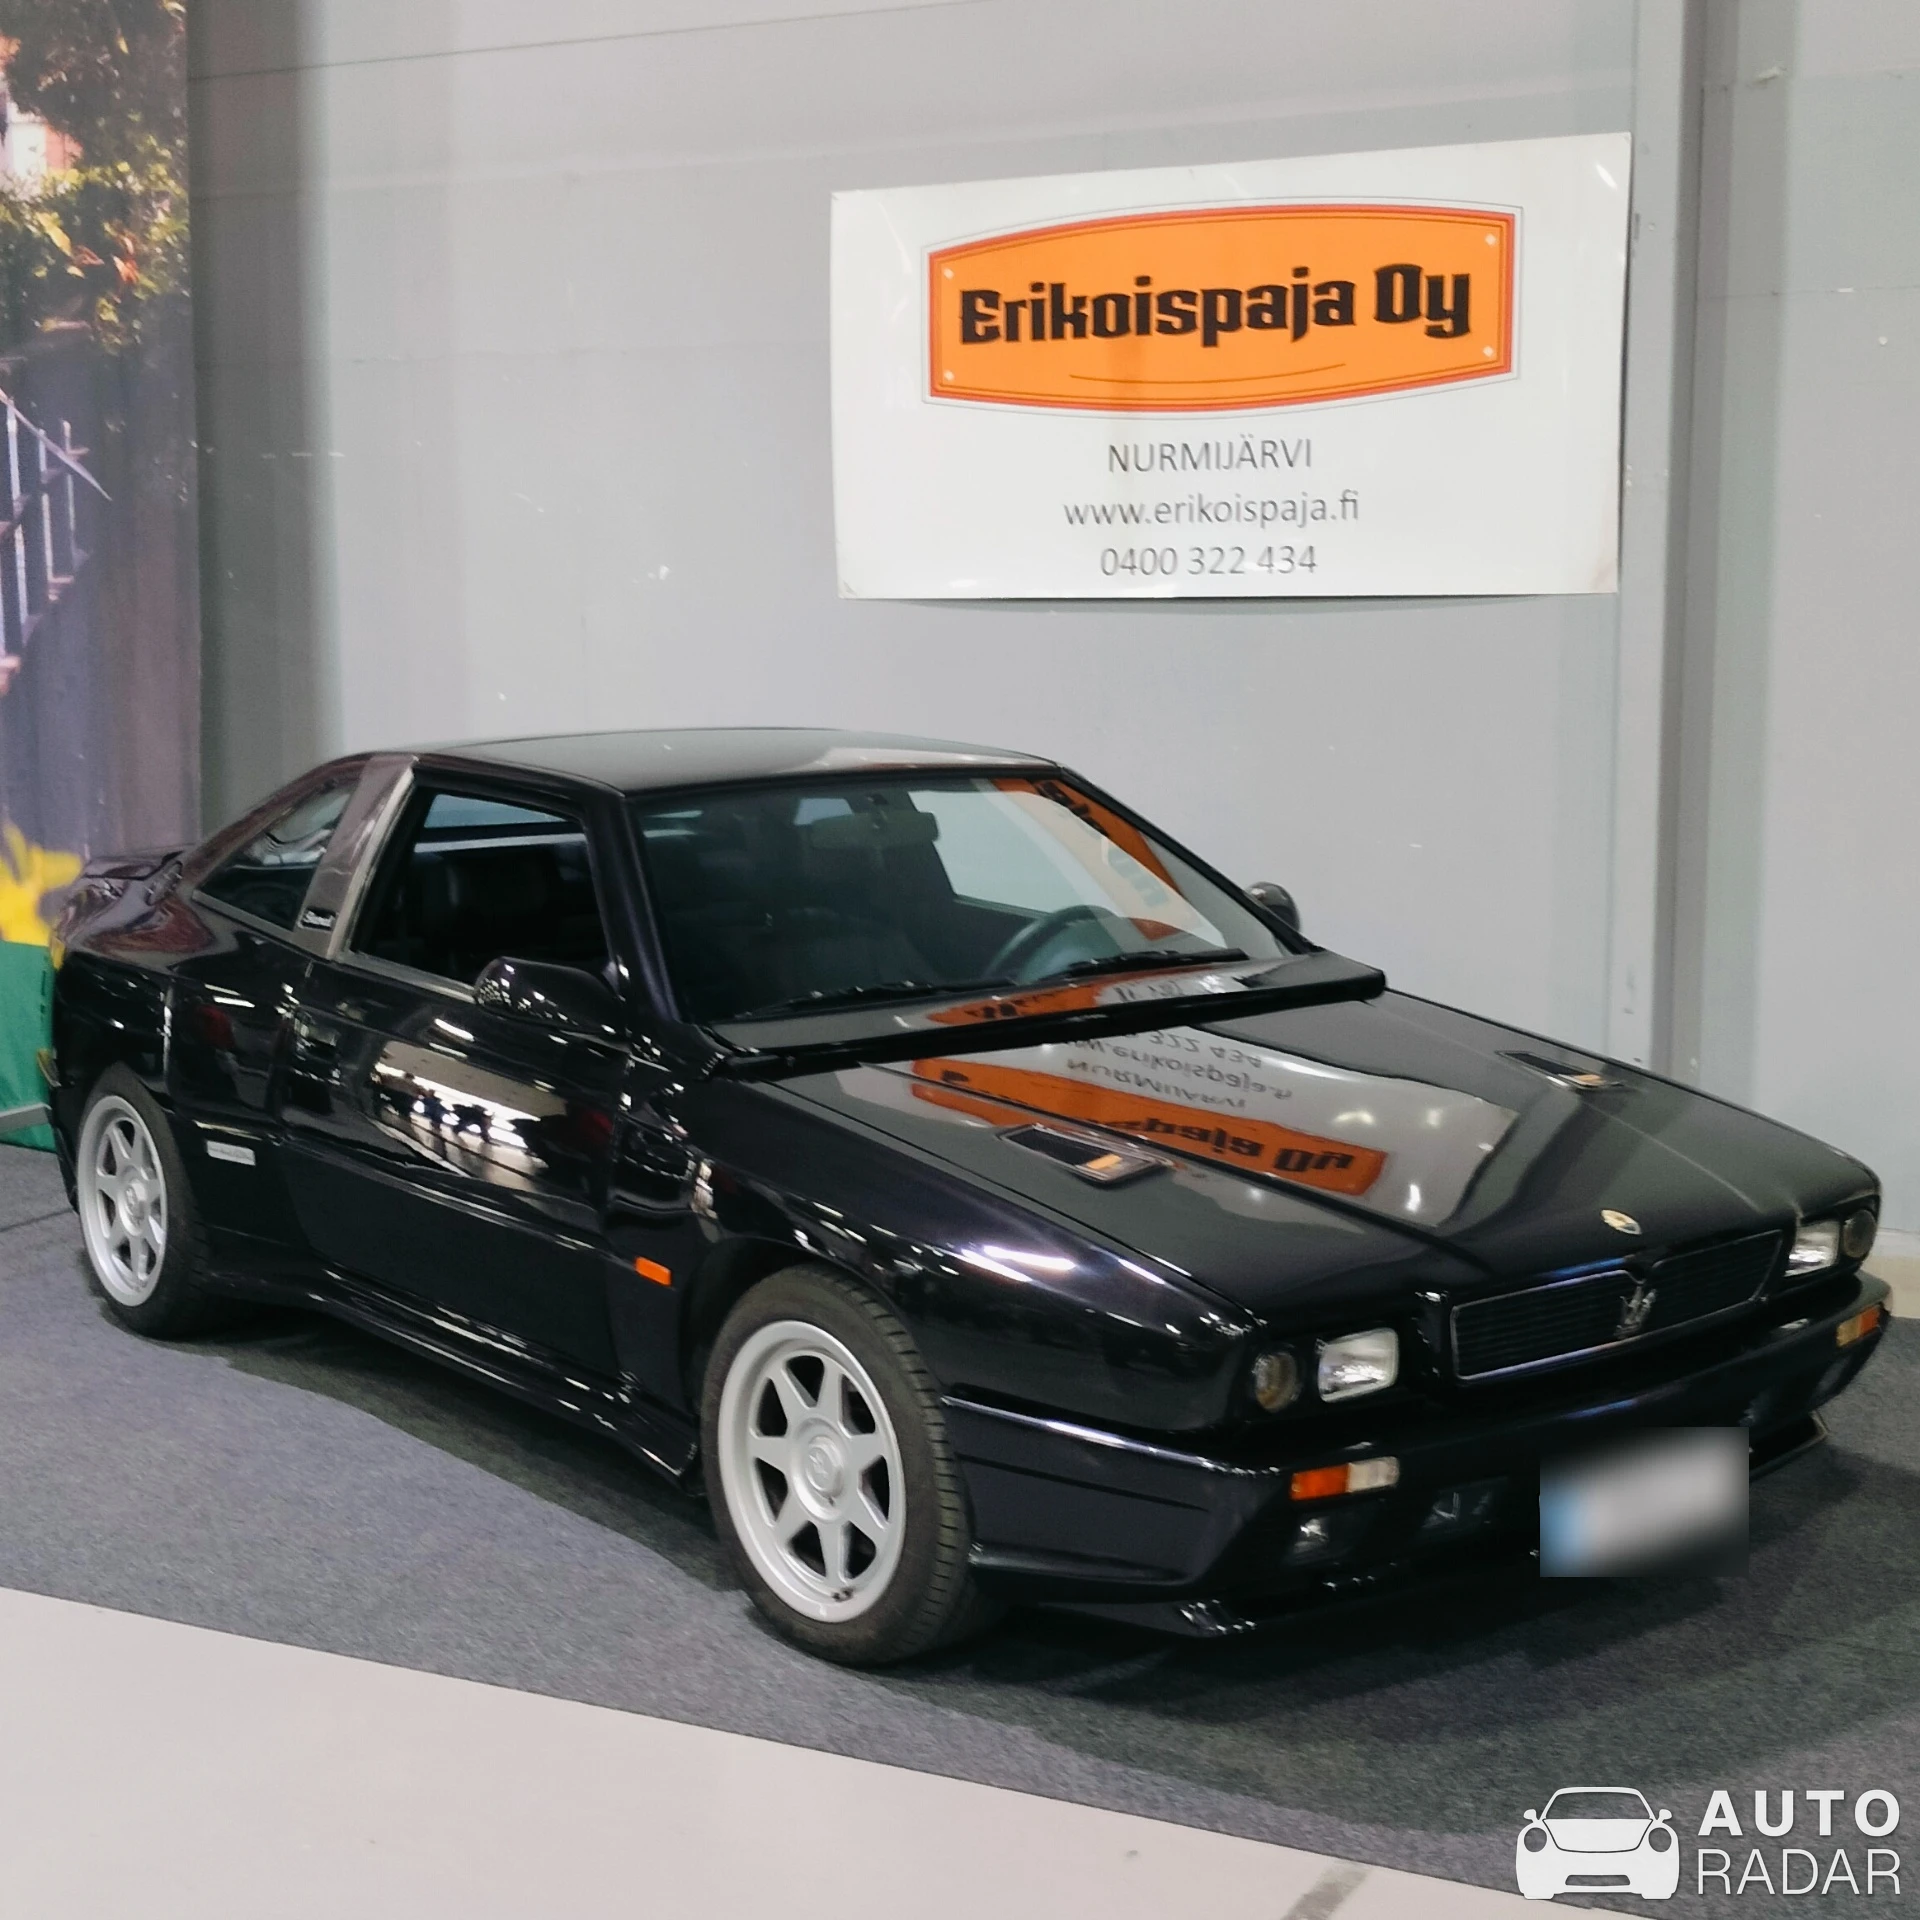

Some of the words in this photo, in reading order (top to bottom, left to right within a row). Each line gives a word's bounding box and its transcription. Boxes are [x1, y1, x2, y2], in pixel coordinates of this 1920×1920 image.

[959, 266, 1358, 348] Erikoispaja
[1373, 263, 1472, 339] Oy
[1108, 434, 1312, 473] NURMIJÄRVI
[1063, 488, 1359, 529] www.erikoispaja.fi
[1100, 547, 1179, 576] 0400
[1187, 545, 1247, 575] 322
[1256, 544, 1318, 574] 434
